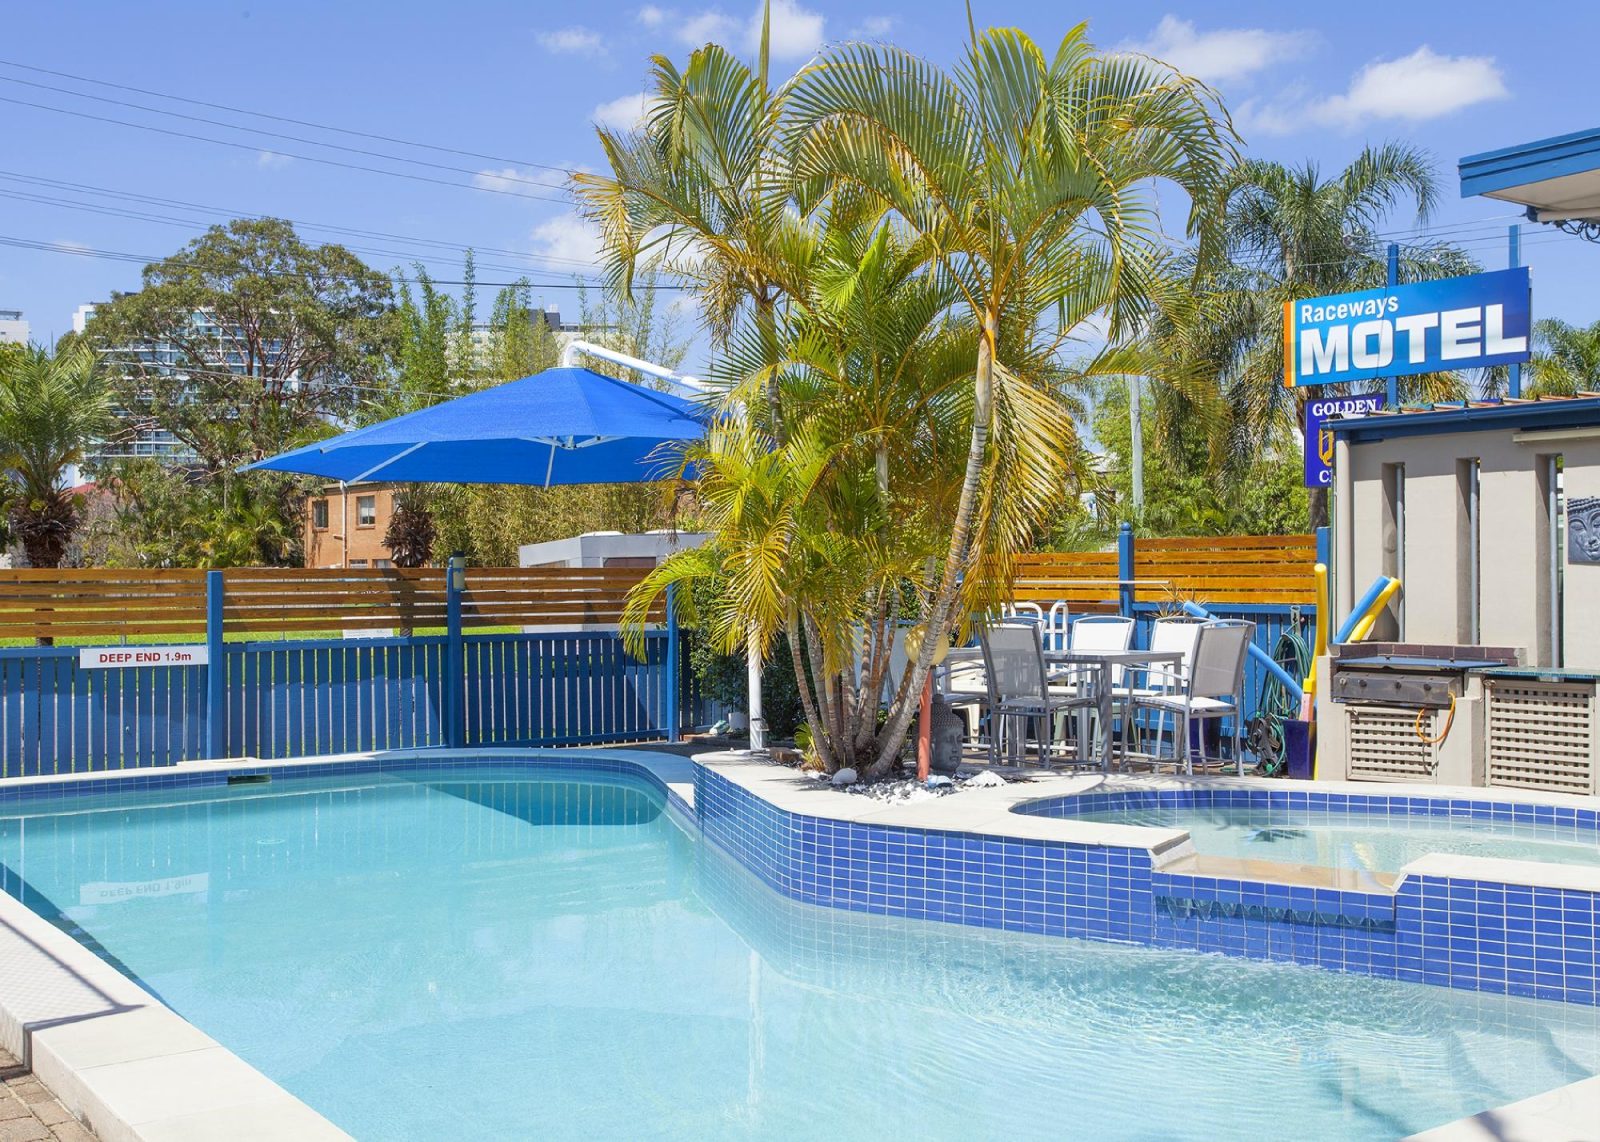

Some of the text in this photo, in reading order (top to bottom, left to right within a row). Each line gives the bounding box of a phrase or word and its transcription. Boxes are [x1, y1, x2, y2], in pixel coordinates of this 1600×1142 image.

[1301, 295, 1399, 324] Raceways
[1300, 303, 1527, 376] MOTEL
[1312, 399, 1376, 416] GOLDEN
[100, 652, 192, 663] DEEP END 1.9m
